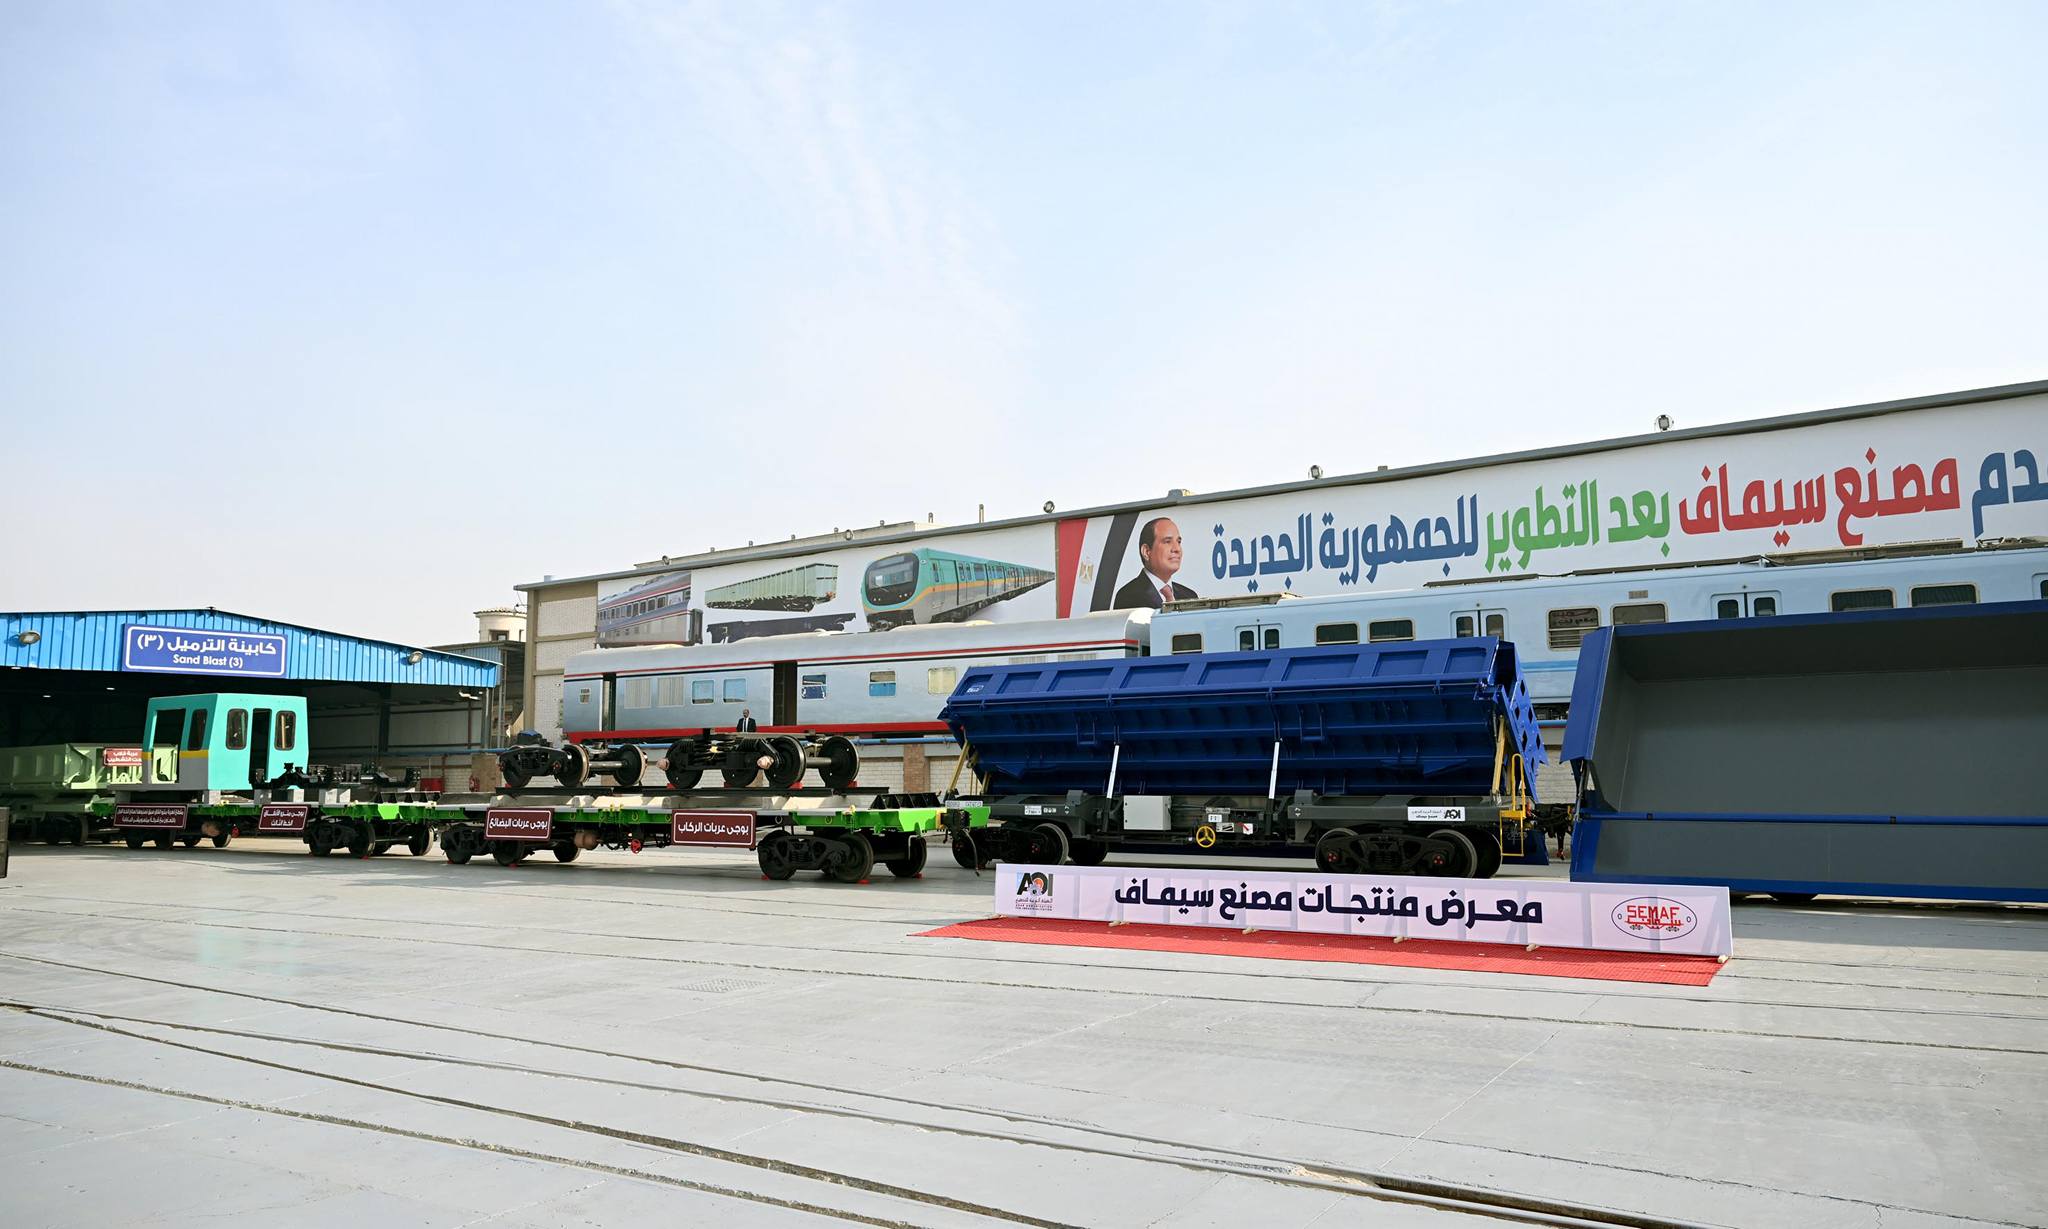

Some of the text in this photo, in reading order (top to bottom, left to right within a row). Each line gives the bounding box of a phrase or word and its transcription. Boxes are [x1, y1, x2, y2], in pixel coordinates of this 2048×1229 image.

[1678, 462, 1827, 548] سيماف
[1834, 447, 1961, 547] مصنع
[1484, 478, 1600, 574] التطوير
[1607, 489, 1671, 558] بعد
[1318, 493, 1479, 586] للجمهورية
[1211, 511, 1313, 593] الجديدة
[137, 633, 277, 657] كابينة الترميل (٣)
[172, 653, 243, 669] Sand Blast (3)
[489, 817, 512, 829] البضائع
[512, 818, 530, 829] عربات
[677, 820, 703, 834] الركاب
[703, 821, 726, 835] عربات
[1016, 872, 1054, 896] AOI
[1114, 878, 1543, 930] معرض منتجات مصنع سيماف
[1626, 905, 1680, 921] SEMAF
